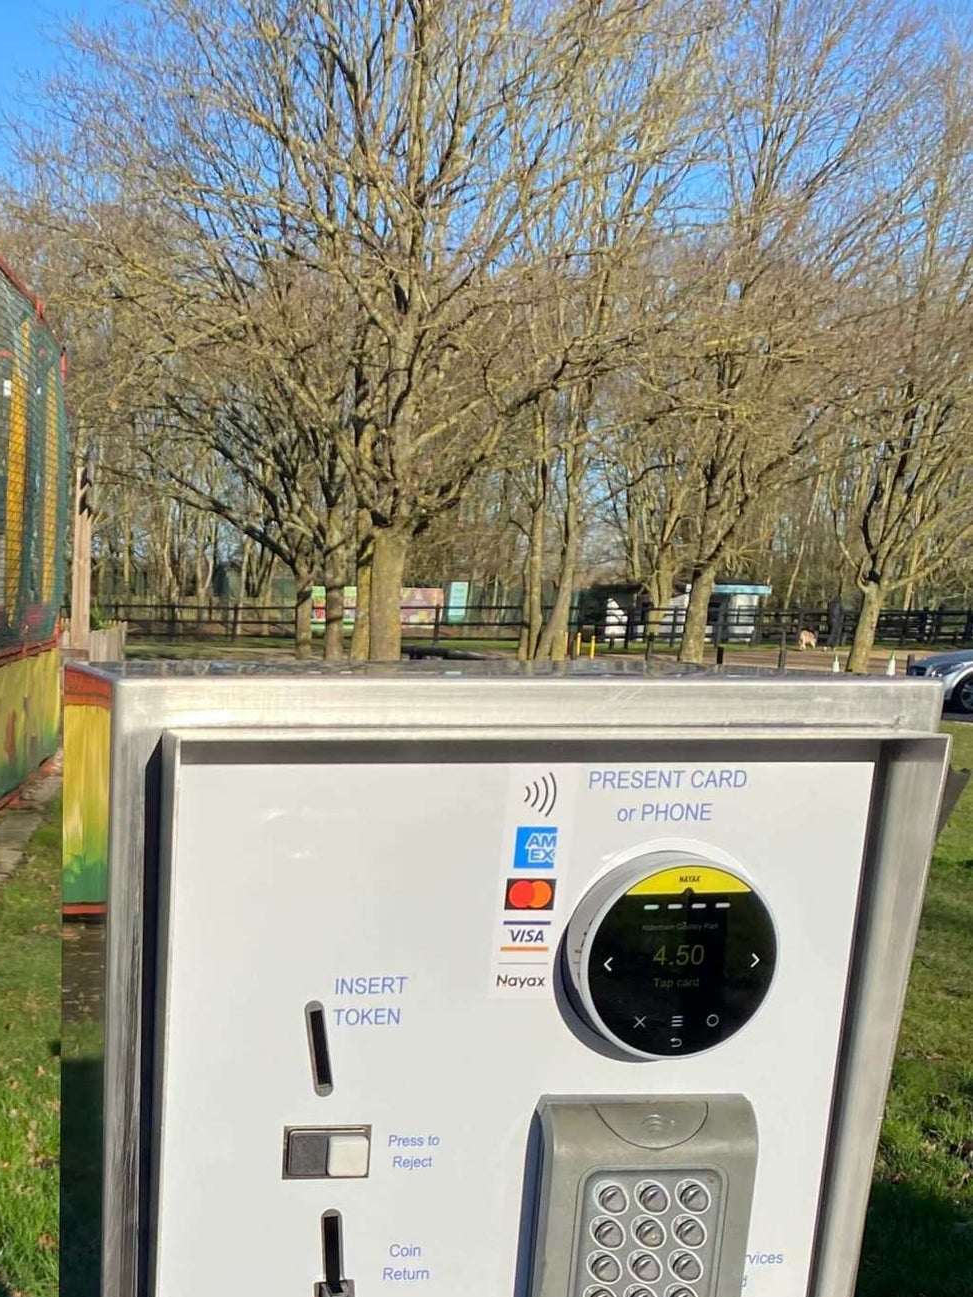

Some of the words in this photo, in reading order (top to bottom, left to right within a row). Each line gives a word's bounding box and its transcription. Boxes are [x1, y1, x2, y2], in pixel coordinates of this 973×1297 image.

[588, 769, 685, 790] PRESENT
[690, 769, 748, 790] CARD
[617, 807, 636, 822] or
[641, 803, 713, 822] PHONE
[527, 834, 557, 848] AM
[509, 930, 544, 942] VISA
[653, 944, 704, 966] 4.50
[334, 977, 407, 995] INSERT
[496, 974, 545, 988] Nayax
[654, 977, 673, 989] Tap
[677, 977, 700, 988] card
[333, 1008, 401, 1027] TOKEN
[388, 1134, 425, 1149] Press
[428, 1135, 440, 1148] to
[392, 1155, 433, 1171] Reject
[389, 1243, 422, 1259] Coin
[383, 1266, 430, 1282] Return
